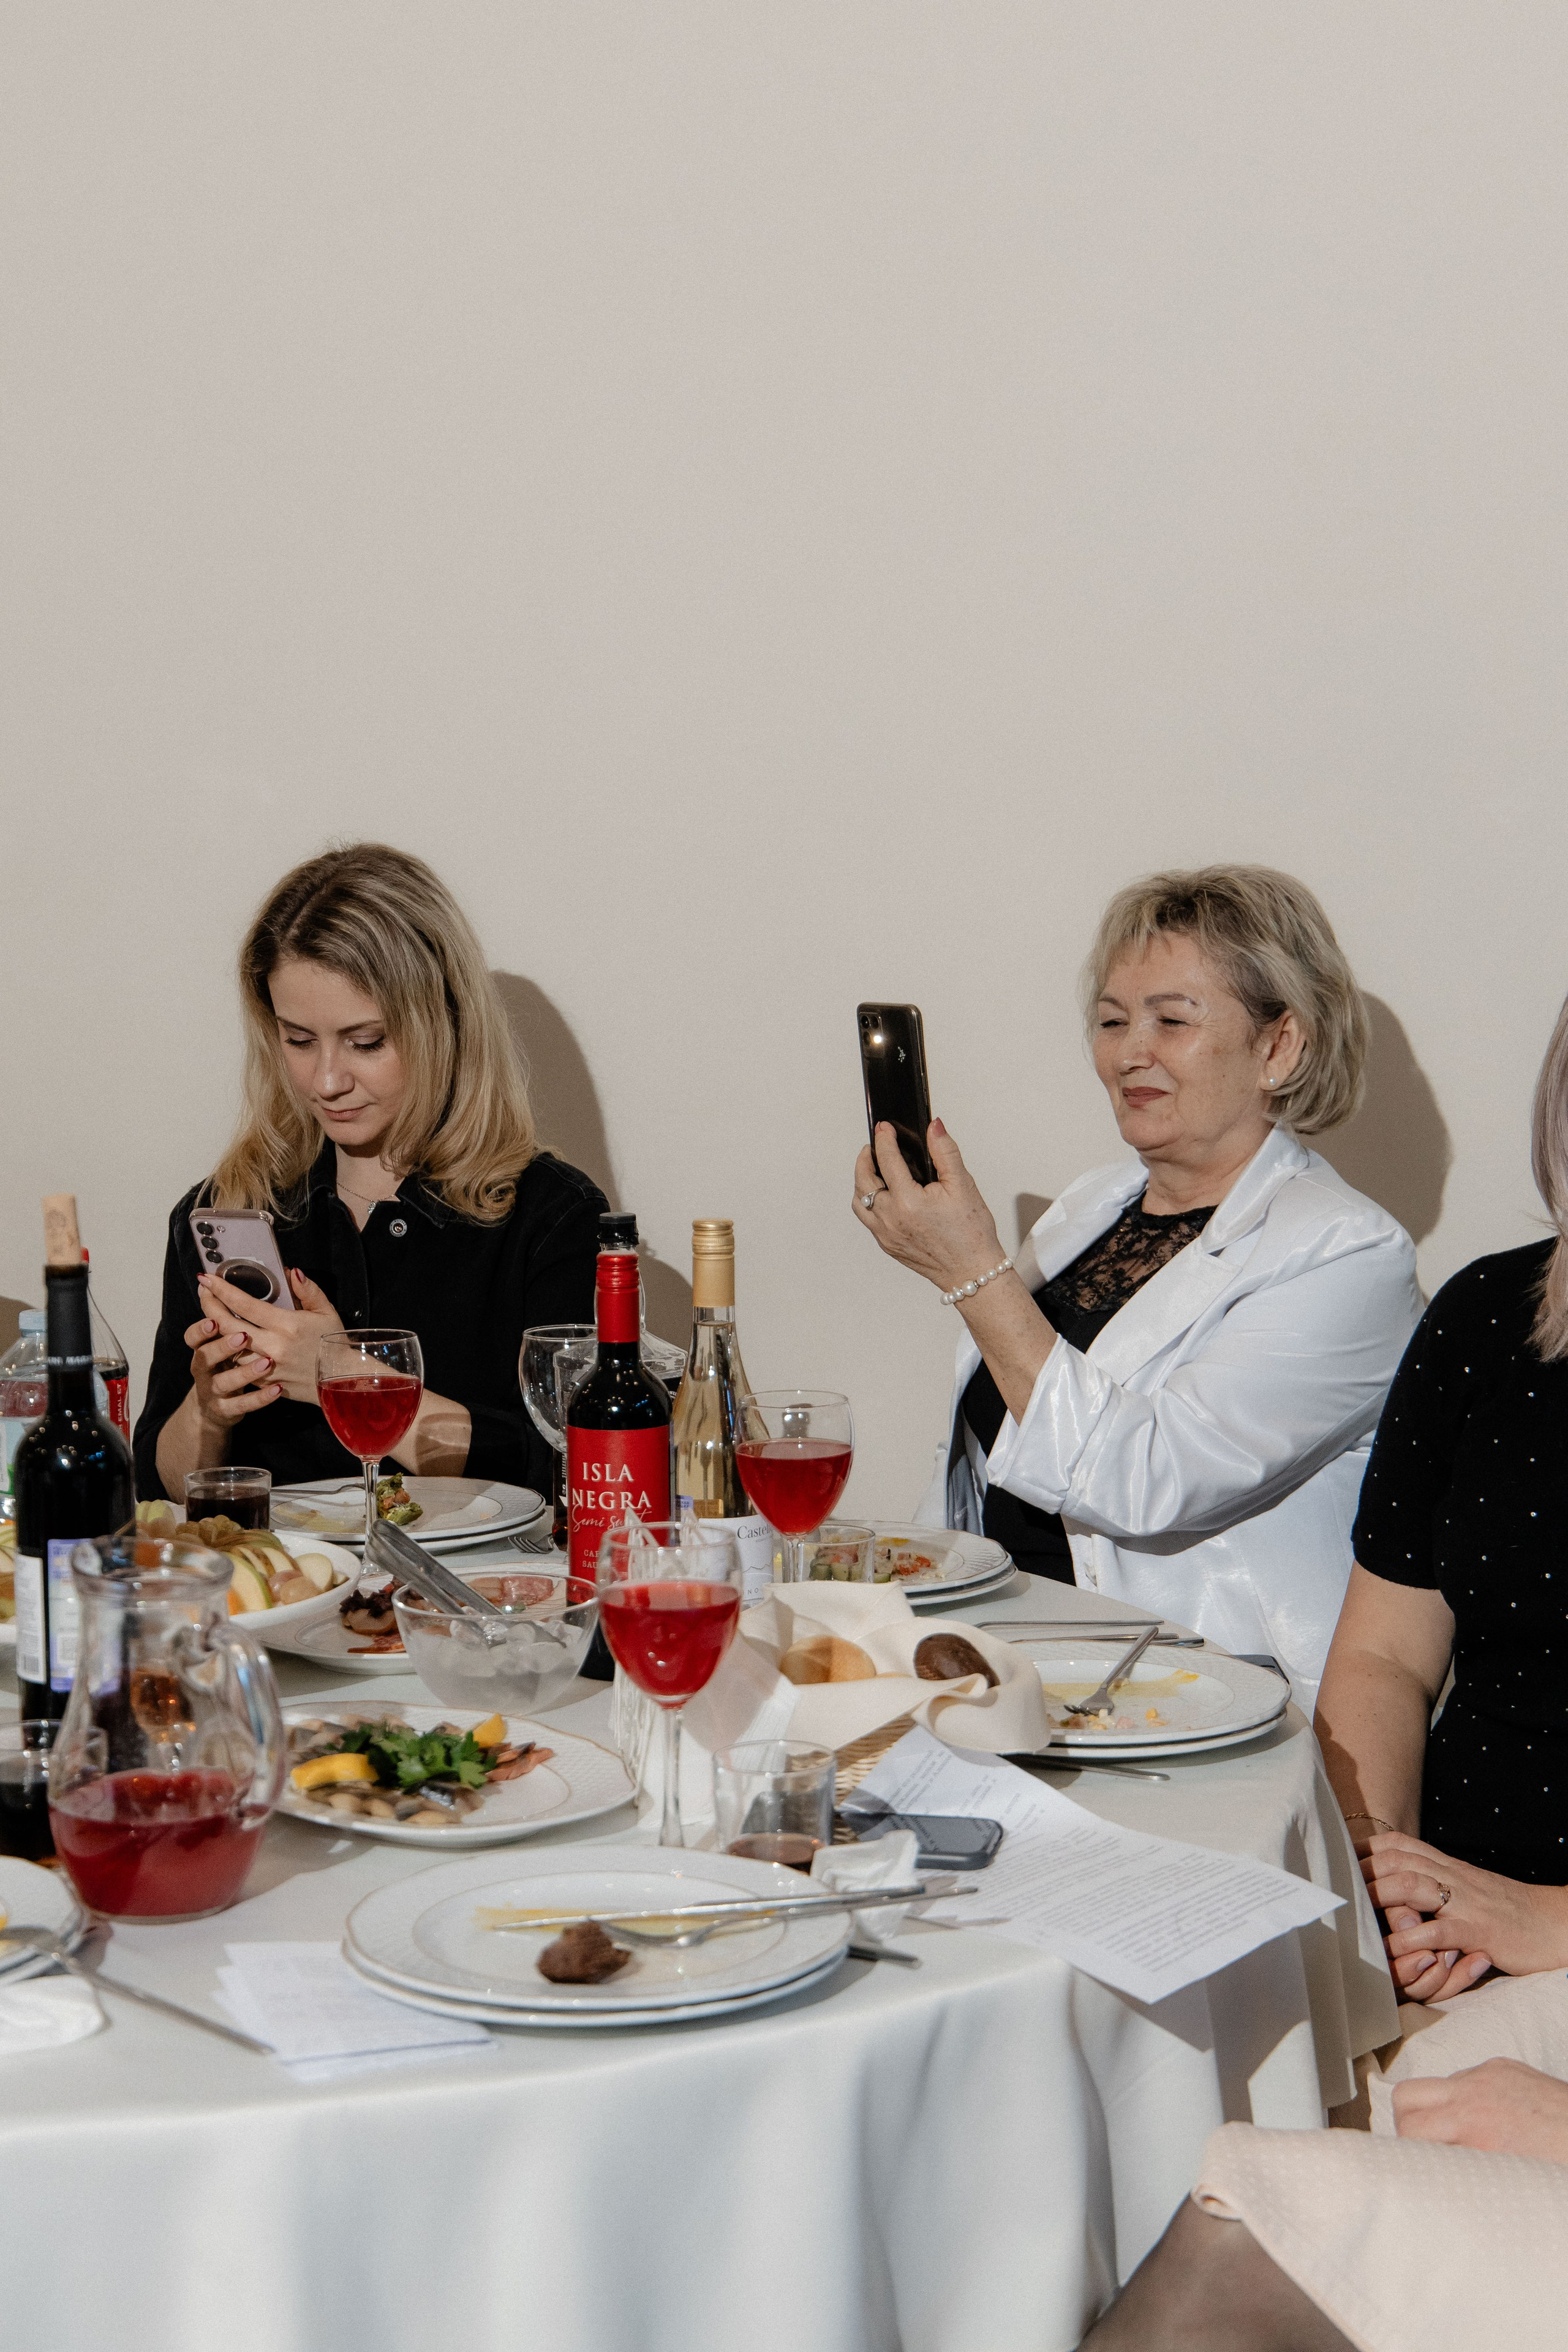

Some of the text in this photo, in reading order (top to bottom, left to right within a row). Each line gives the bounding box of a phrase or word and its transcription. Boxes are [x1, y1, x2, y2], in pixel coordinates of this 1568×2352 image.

[582, 1462, 634, 1482] ISLA
[572, 1488, 652, 1510] NEGRA
[571, 1504, 605, 1532] Semi
